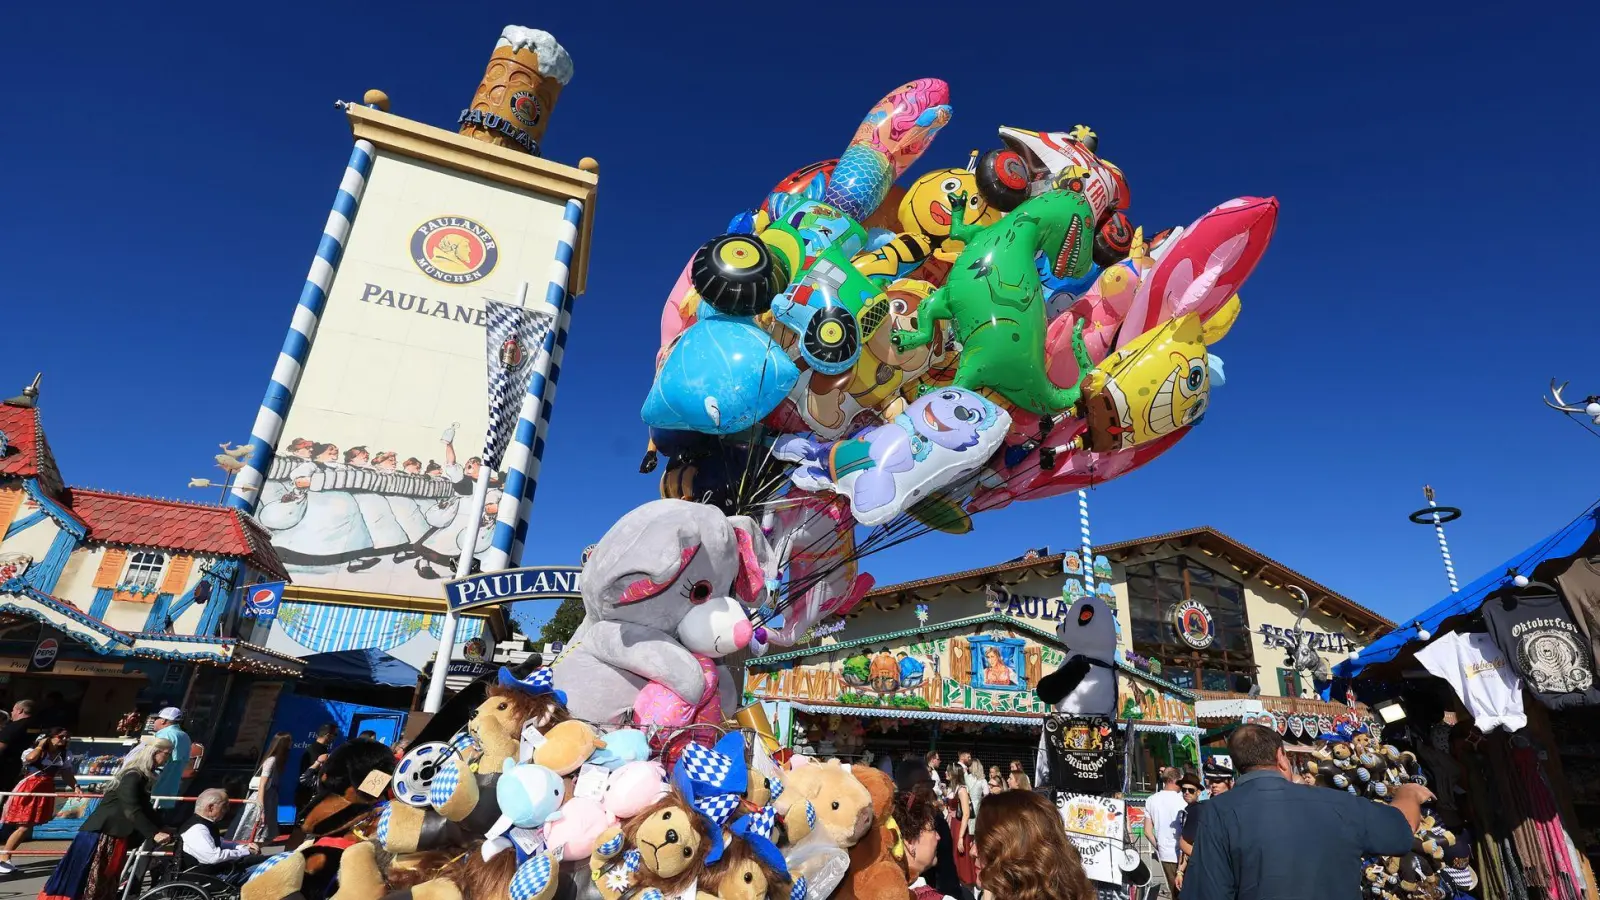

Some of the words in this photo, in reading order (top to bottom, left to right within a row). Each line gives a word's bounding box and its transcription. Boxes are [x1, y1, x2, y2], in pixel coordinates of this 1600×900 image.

[417, 217, 496, 251] PAULANER
[417, 257, 483, 284] MÜNCHEN
[360, 282, 488, 328] PAULANE
[456, 571, 582, 605] PAULAN
[245, 607, 275, 617] pepsi
[1178, 601, 1212, 623] PAULANER
[1183, 631, 1213, 647] MÜNCHEN
[1260, 623, 1345, 654] FESZELT
[1511, 617, 1579, 638] Oktoberfest
[36, 649, 55, 657] PEPSI
